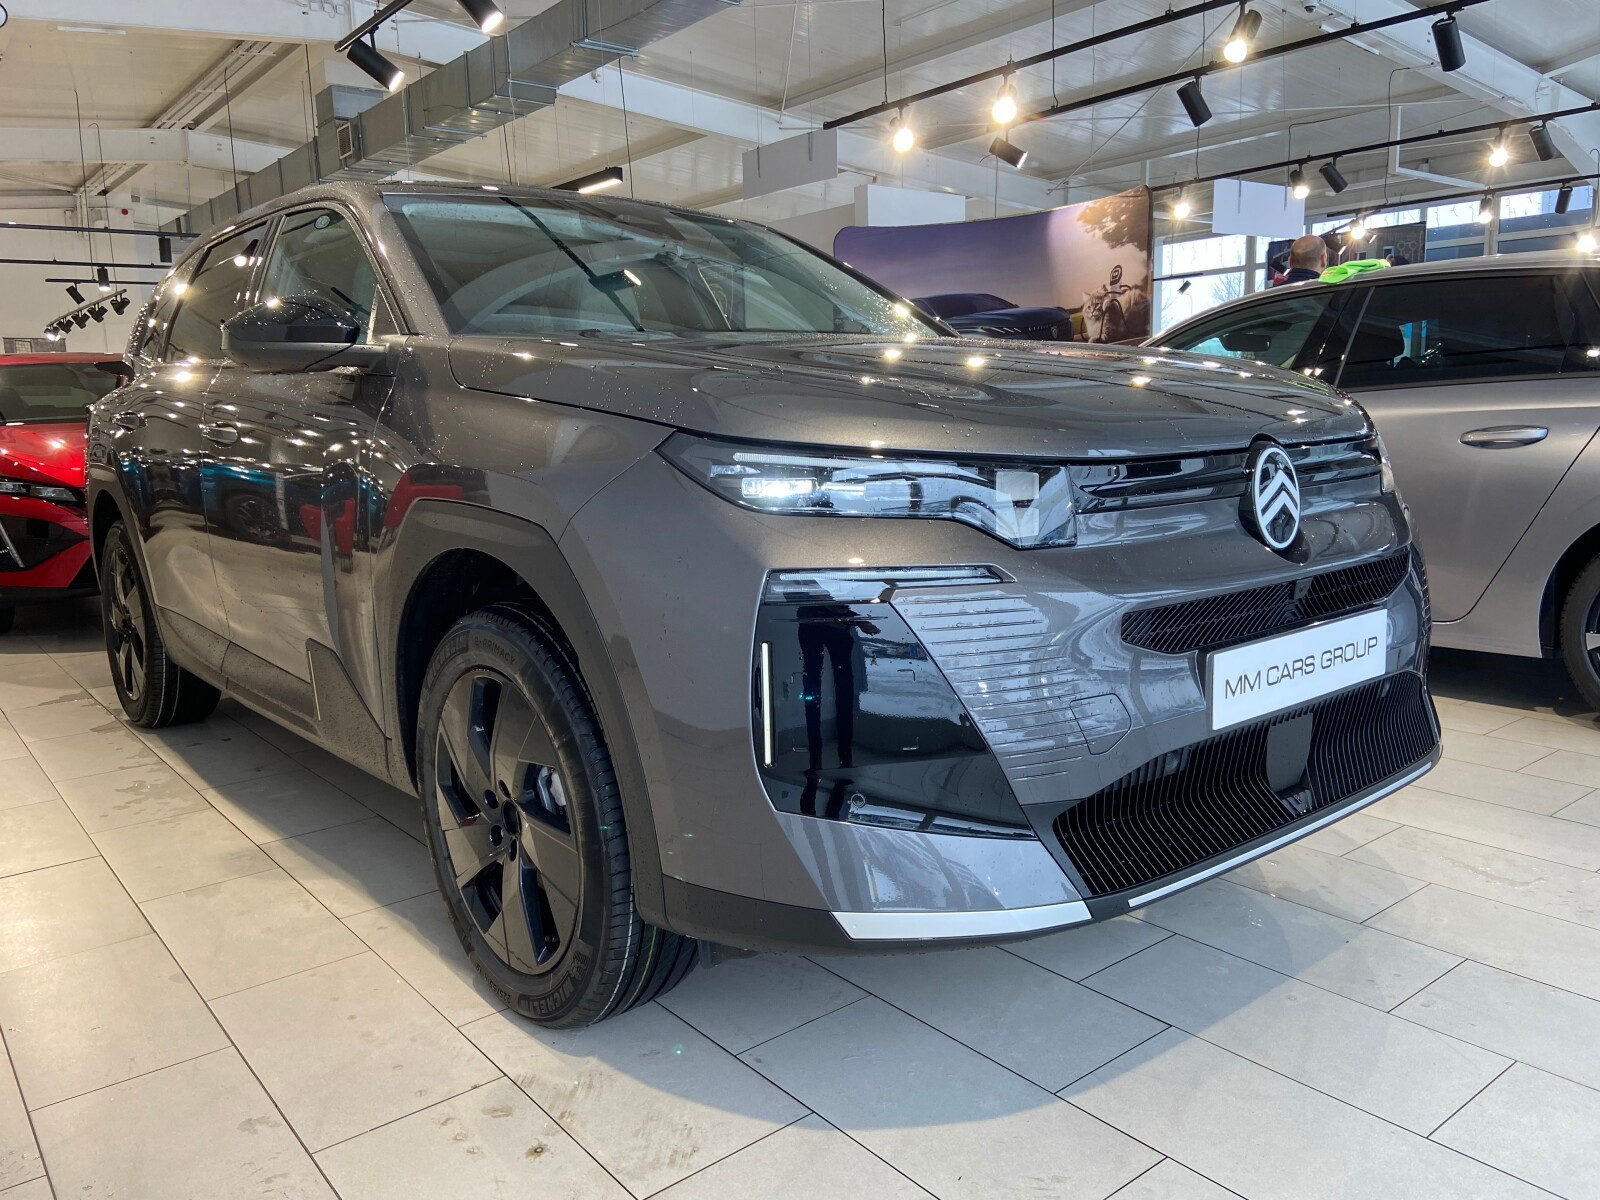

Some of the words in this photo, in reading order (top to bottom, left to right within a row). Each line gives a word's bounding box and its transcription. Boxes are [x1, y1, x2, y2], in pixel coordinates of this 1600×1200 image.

[1225, 670, 1261, 699] MM
[1266, 655, 1315, 686] CARS
[1321, 636, 1378, 670] GROUP
[520, 977, 574, 1016] MICHELIN
